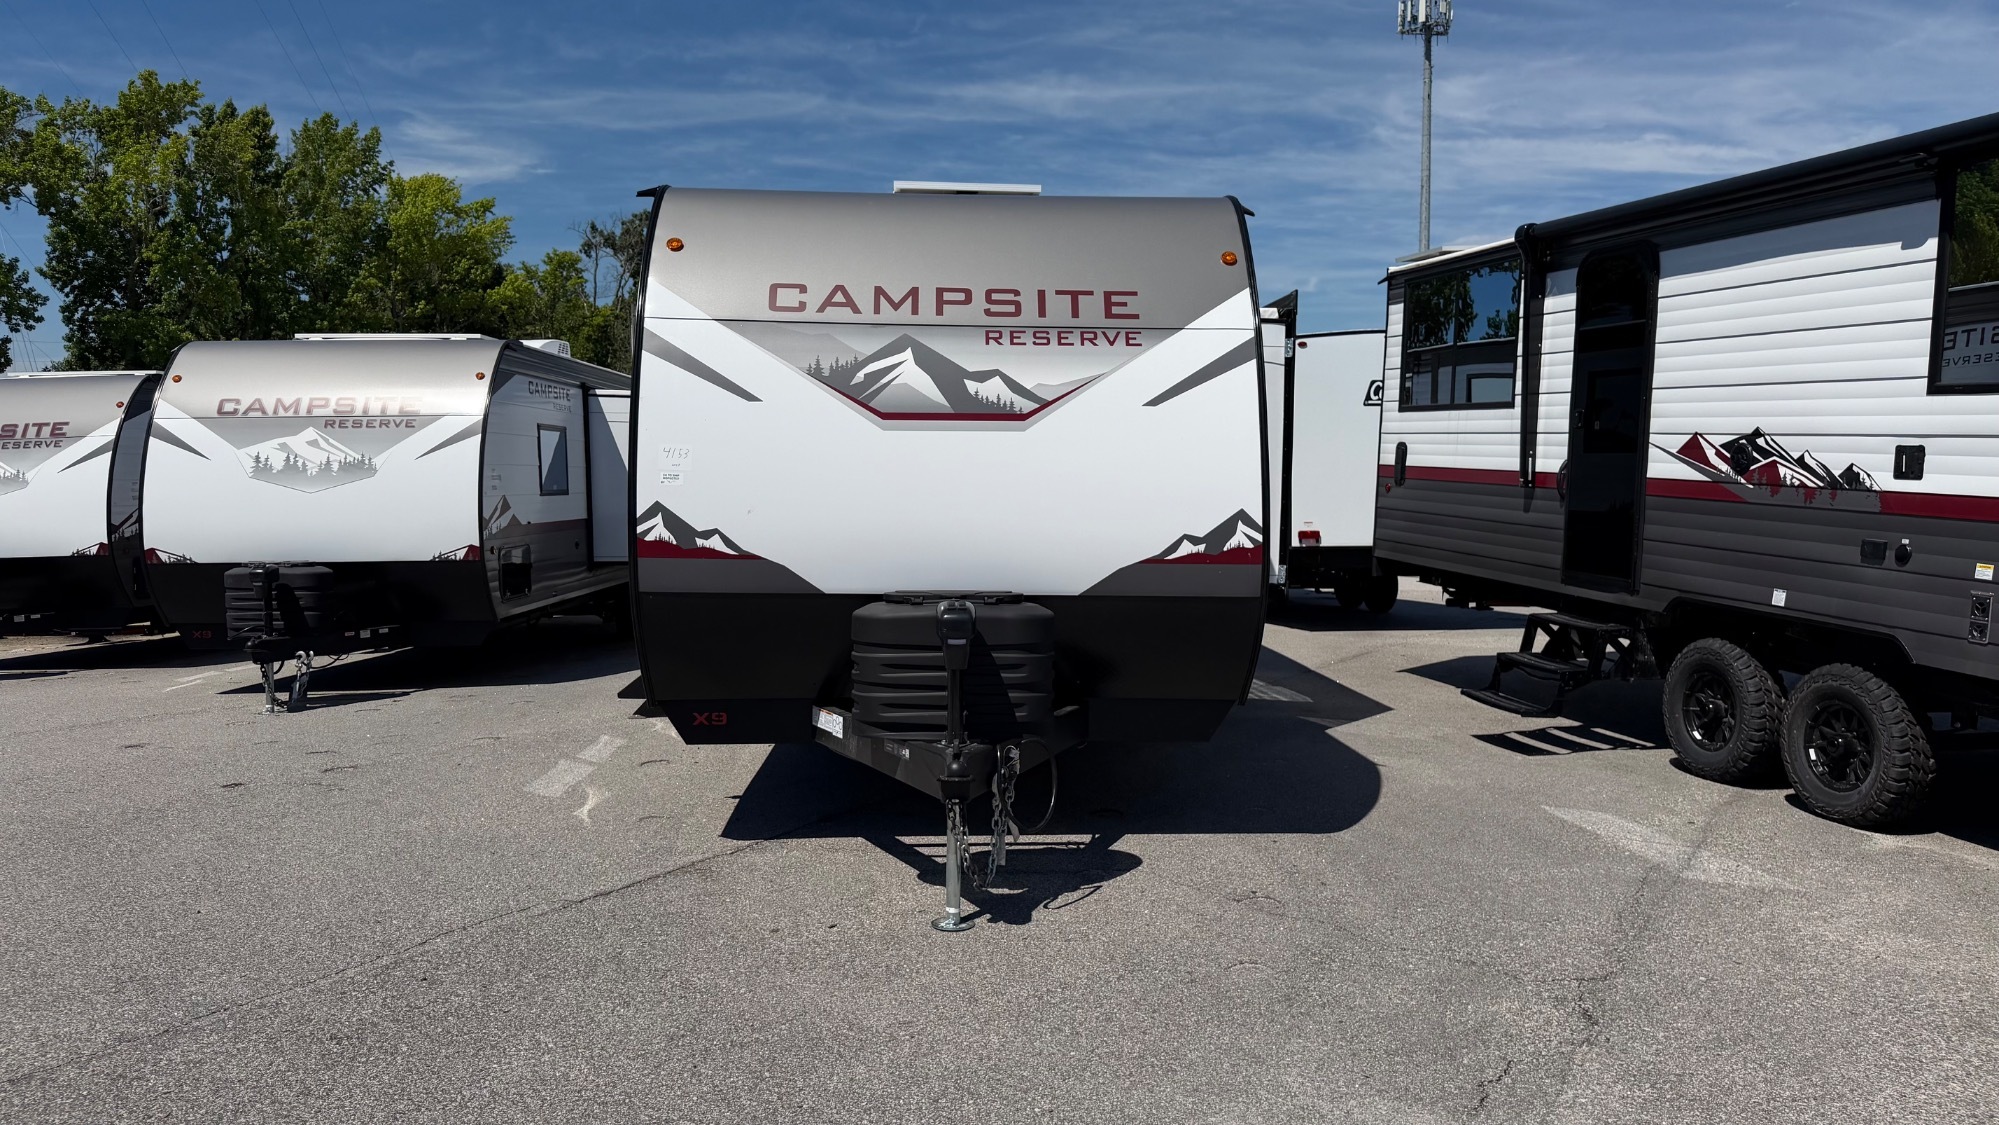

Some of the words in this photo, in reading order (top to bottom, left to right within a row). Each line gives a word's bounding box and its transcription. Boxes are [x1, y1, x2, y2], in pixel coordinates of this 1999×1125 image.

[769, 283, 1140, 320] CAMPSITE
[985, 330, 1142, 347] RESERVE
[528, 381, 571, 402] CAMPSITE
[216, 397, 423, 416] CAMPSITE
[0, 421, 70, 439] SITE
[323, 418, 417, 429] RESERVE
[1, 440, 63, 449] ESERVE
[192, 631, 211, 639] X9
[692, 712, 727, 726] X9
